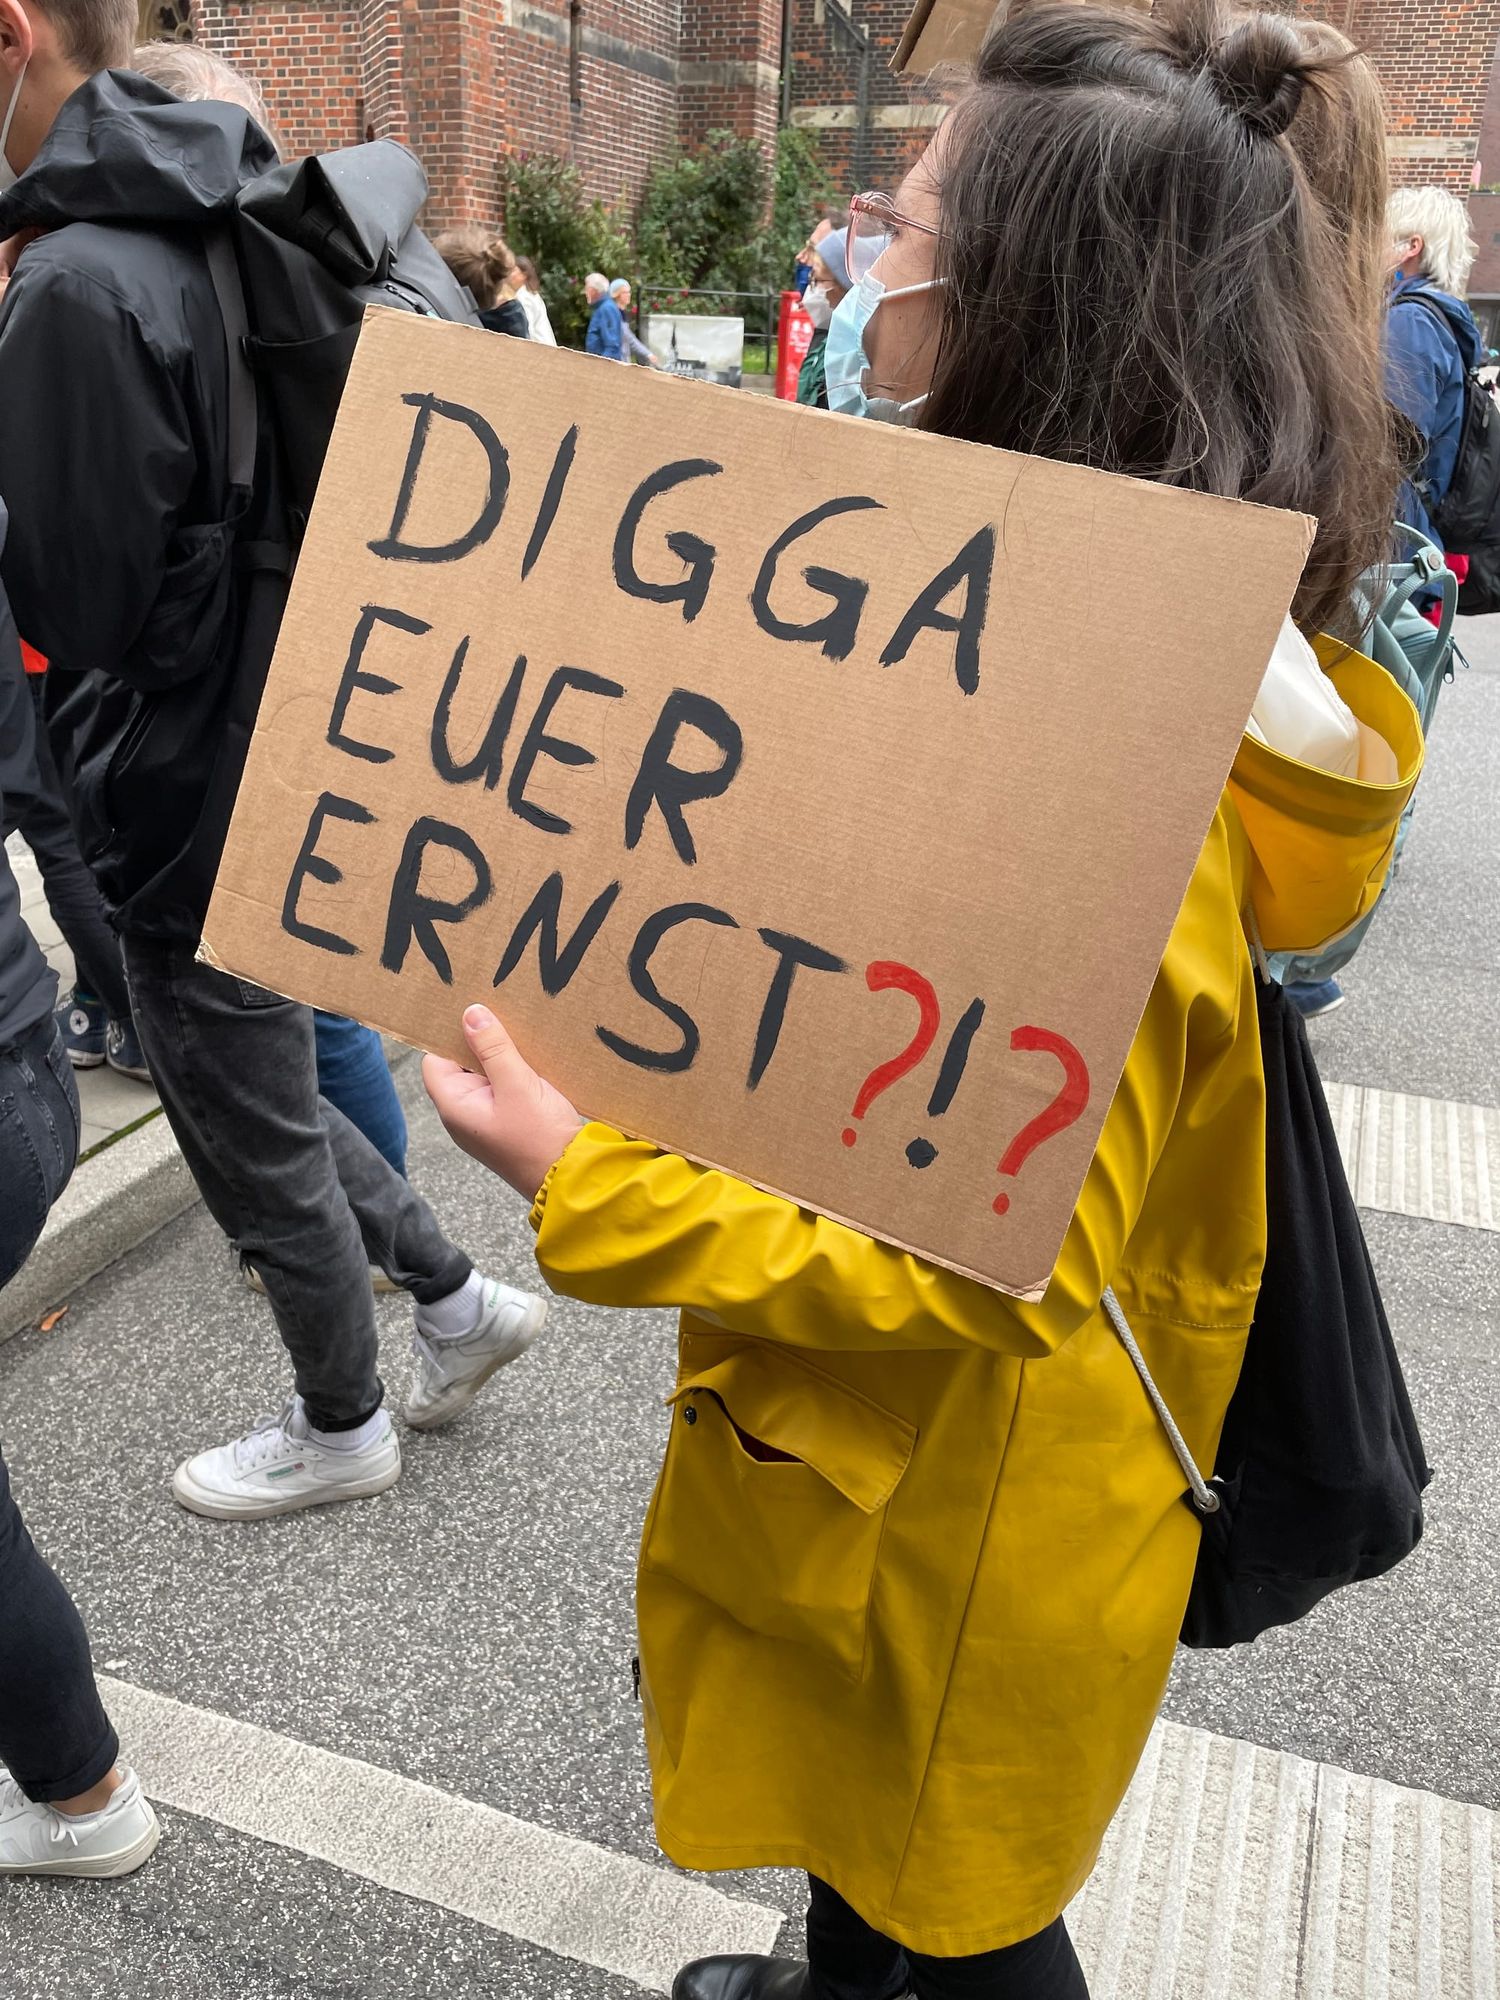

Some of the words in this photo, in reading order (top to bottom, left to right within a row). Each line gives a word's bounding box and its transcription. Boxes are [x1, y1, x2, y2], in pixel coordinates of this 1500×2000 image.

[367, 392, 999, 697] DIGGA
[326, 605, 744, 866] EUER
[281, 791, 1091, 1216] ERNST?!?
